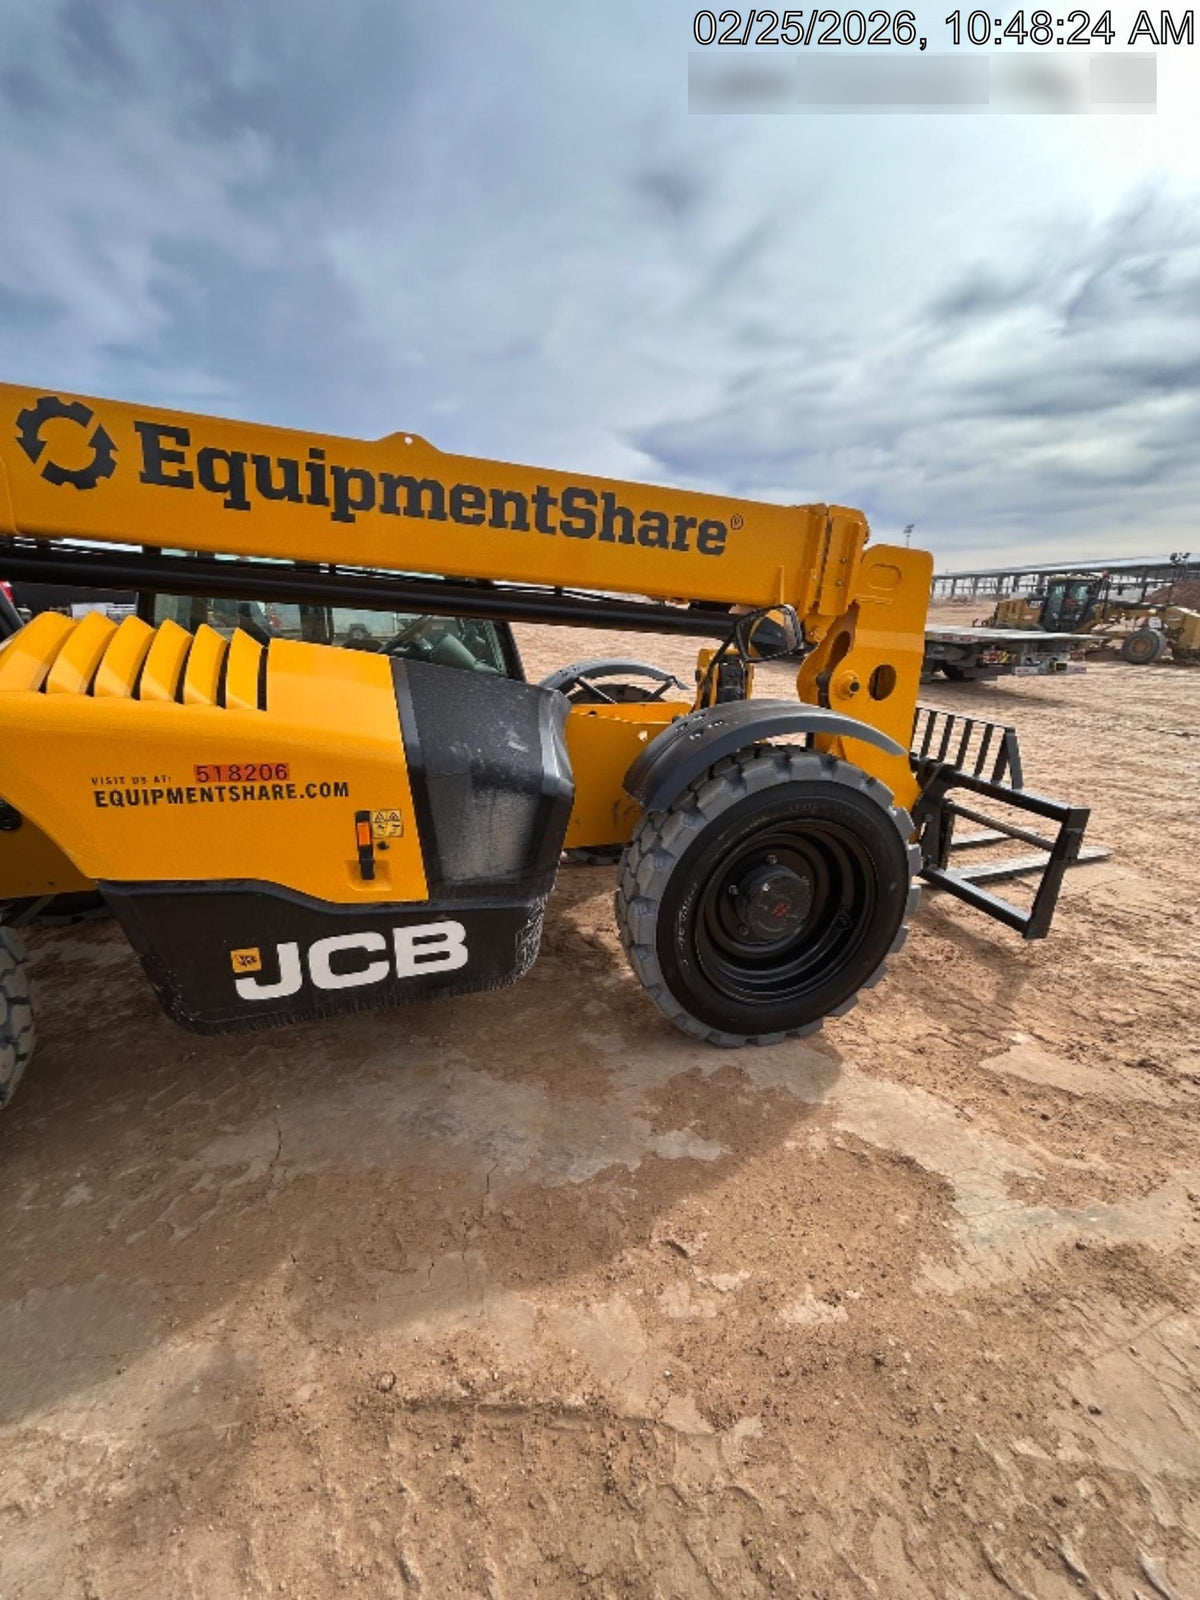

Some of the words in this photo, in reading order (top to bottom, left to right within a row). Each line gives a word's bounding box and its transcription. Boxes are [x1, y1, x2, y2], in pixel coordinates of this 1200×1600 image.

[133, 420, 728, 557] EquipmentShare
[91, 776, 125, 786] VISIT
[131, 776, 147, 785] US
[195, 763, 289, 783] 518206
[93, 782, 349, 808] EQUIPMENTSHARE.COM
[234, 920, 469, 1000] JCB
